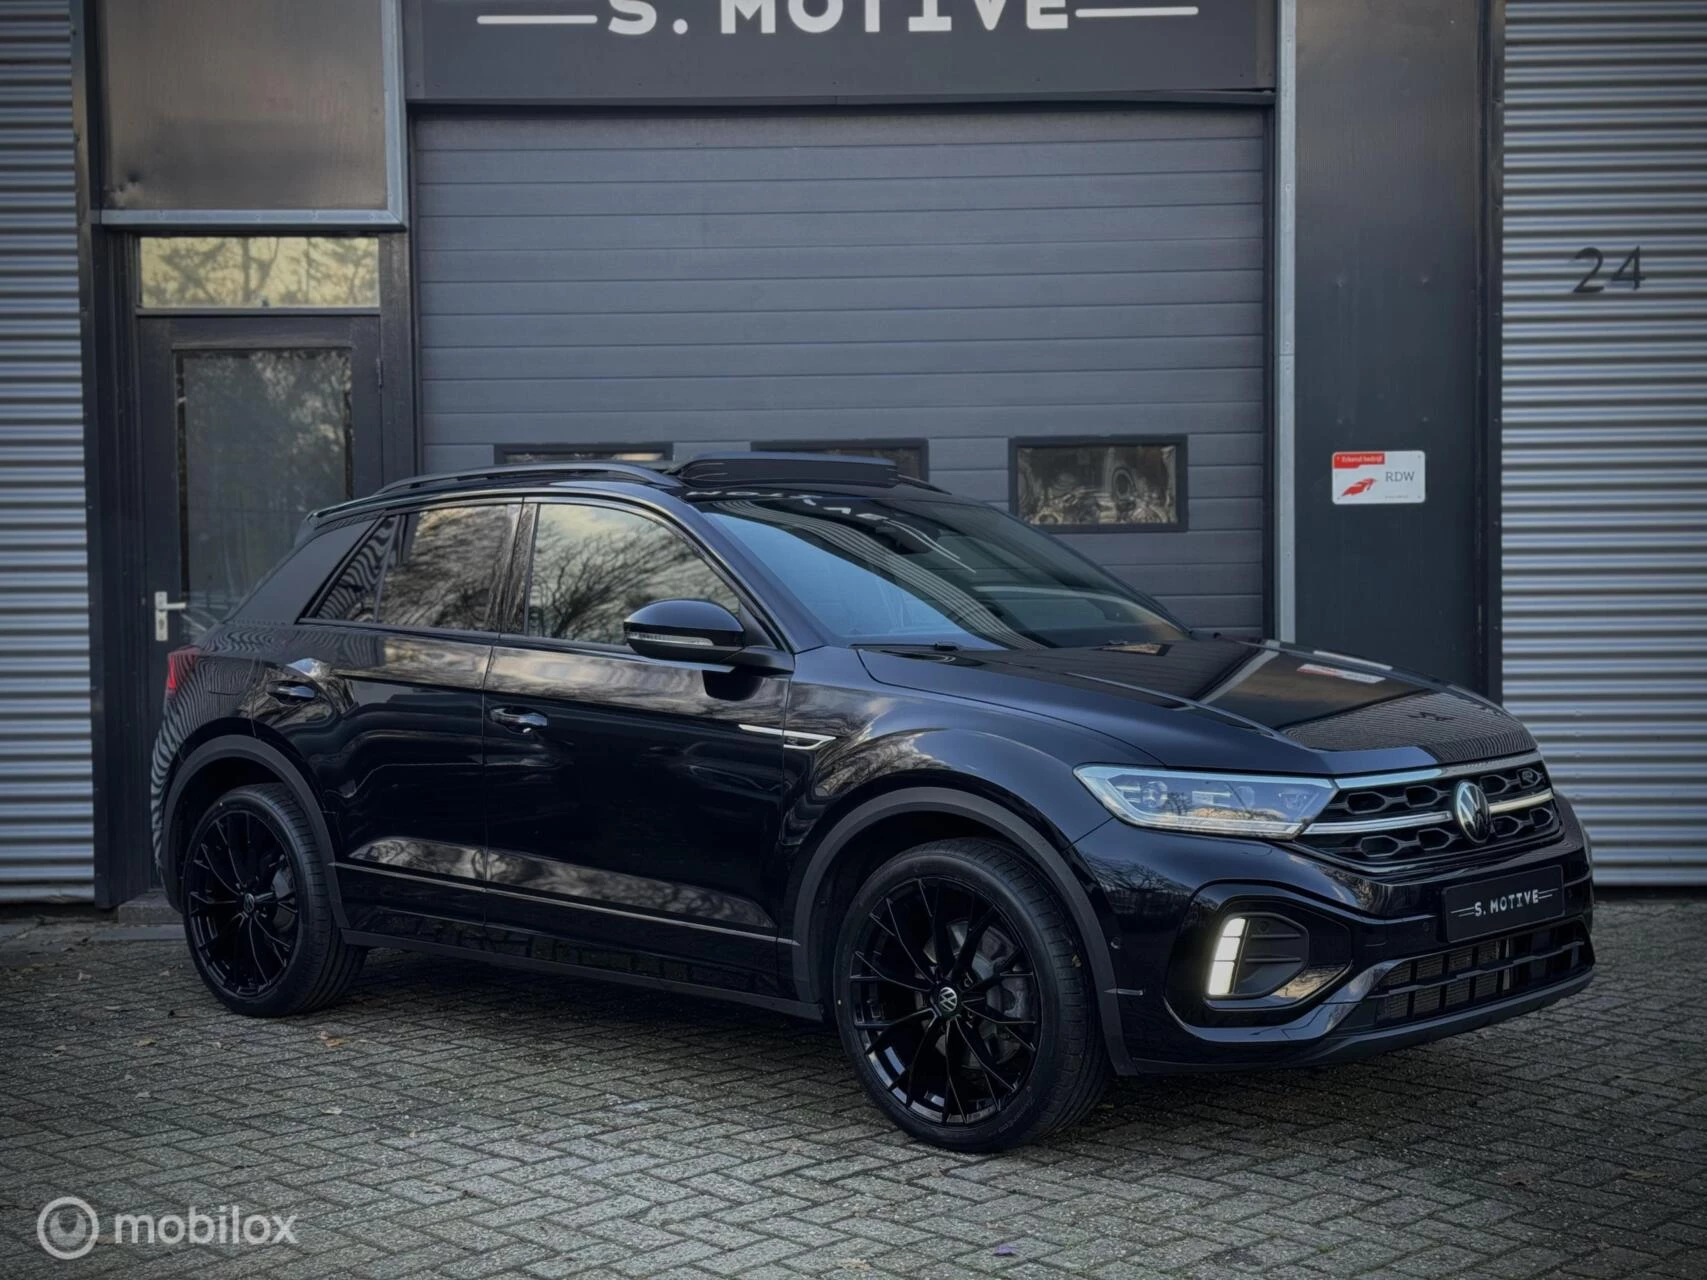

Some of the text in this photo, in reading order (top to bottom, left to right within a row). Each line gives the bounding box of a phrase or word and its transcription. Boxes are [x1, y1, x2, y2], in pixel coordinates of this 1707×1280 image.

[1572, 245, 1647, 294] 24
[1385, 471, 1415, 482] RDW
[1474, 889, 1539, 917] S. MOTIVE
